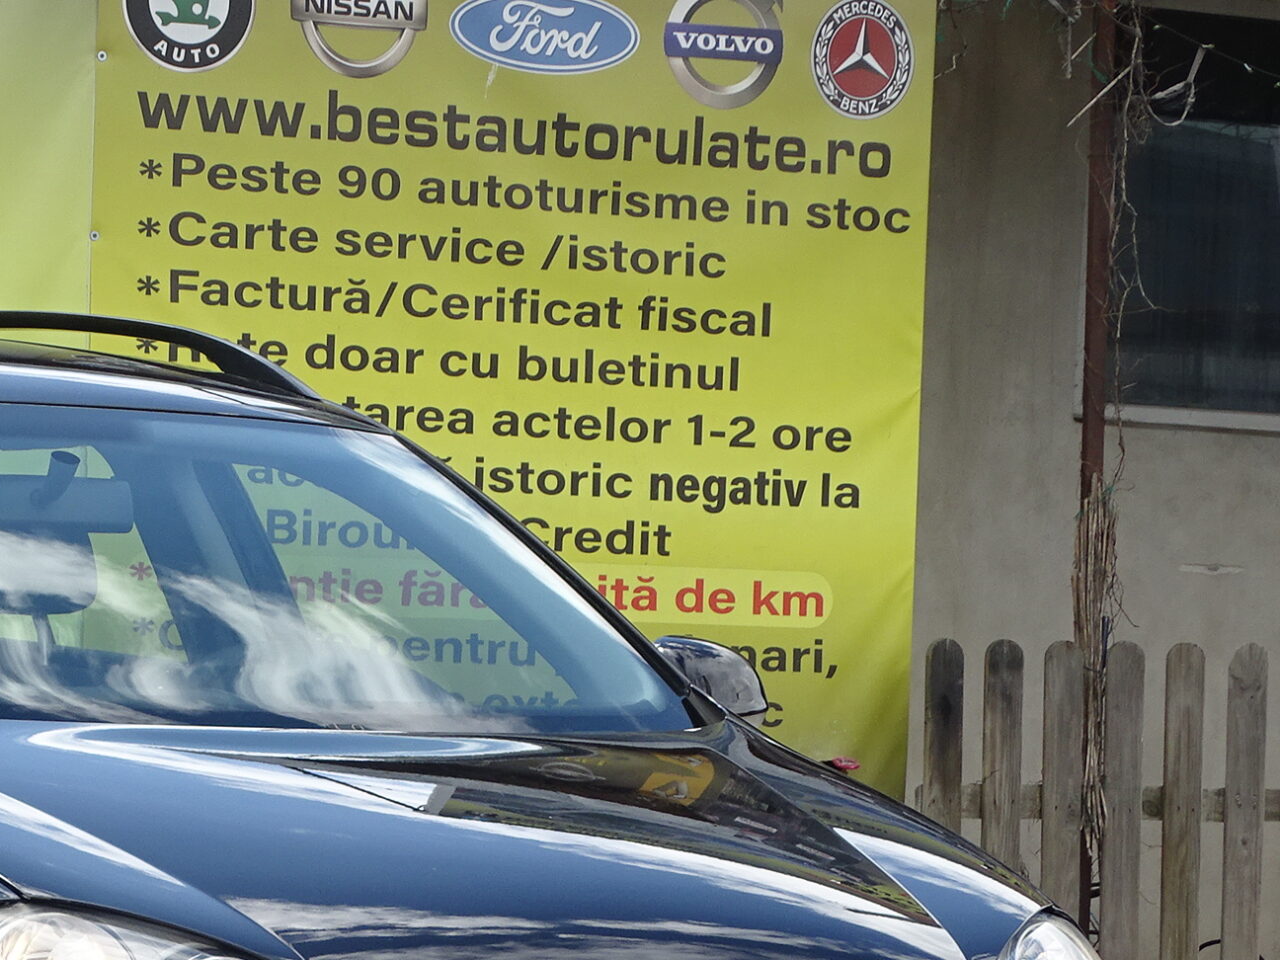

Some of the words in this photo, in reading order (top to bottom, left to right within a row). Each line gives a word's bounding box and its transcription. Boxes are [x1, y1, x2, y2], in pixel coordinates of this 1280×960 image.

[304, 0, 414, 21] NISSAN
[489, 1, 602, 59] Ford
[833, 1, 897, 29] MERCEDES
[153, 39, 221, 64] AUTO
[673, 31, 775, 55] VOLVO
[839, 98, 879, 115] BENZ
[137, 89, 892, 179] www.bestautorulate.ro
[338, 164, 401, 201] 90
[418, 175, 730, 223] autoturisme
[746, 189, 789, 227] in
[806, 198, 911, 234] stoc
[335, 227, 526, 267] service
[540, 234, 727, 279] /istoric
[638, 296, 772, 337] fiscal
[305, 334, 424, 375] doar
[440, 349, 500, 380] cu
[517, 345, 740, 391] buletinul
[492, 407, 672, 445] actelor
[687, 414, 757, 449] 1-2
[772, 424, 853, 453] ore
[473, 457, 633, 499] istoric
[650, 468, 808, 513] negativ
[821, 473, 861, 509] la
[266, 508, 418, 551] Birou
[399, 567, 488, 609] făr
[675, 578, 736, 615] de
[752, 580, 825, 618] km
